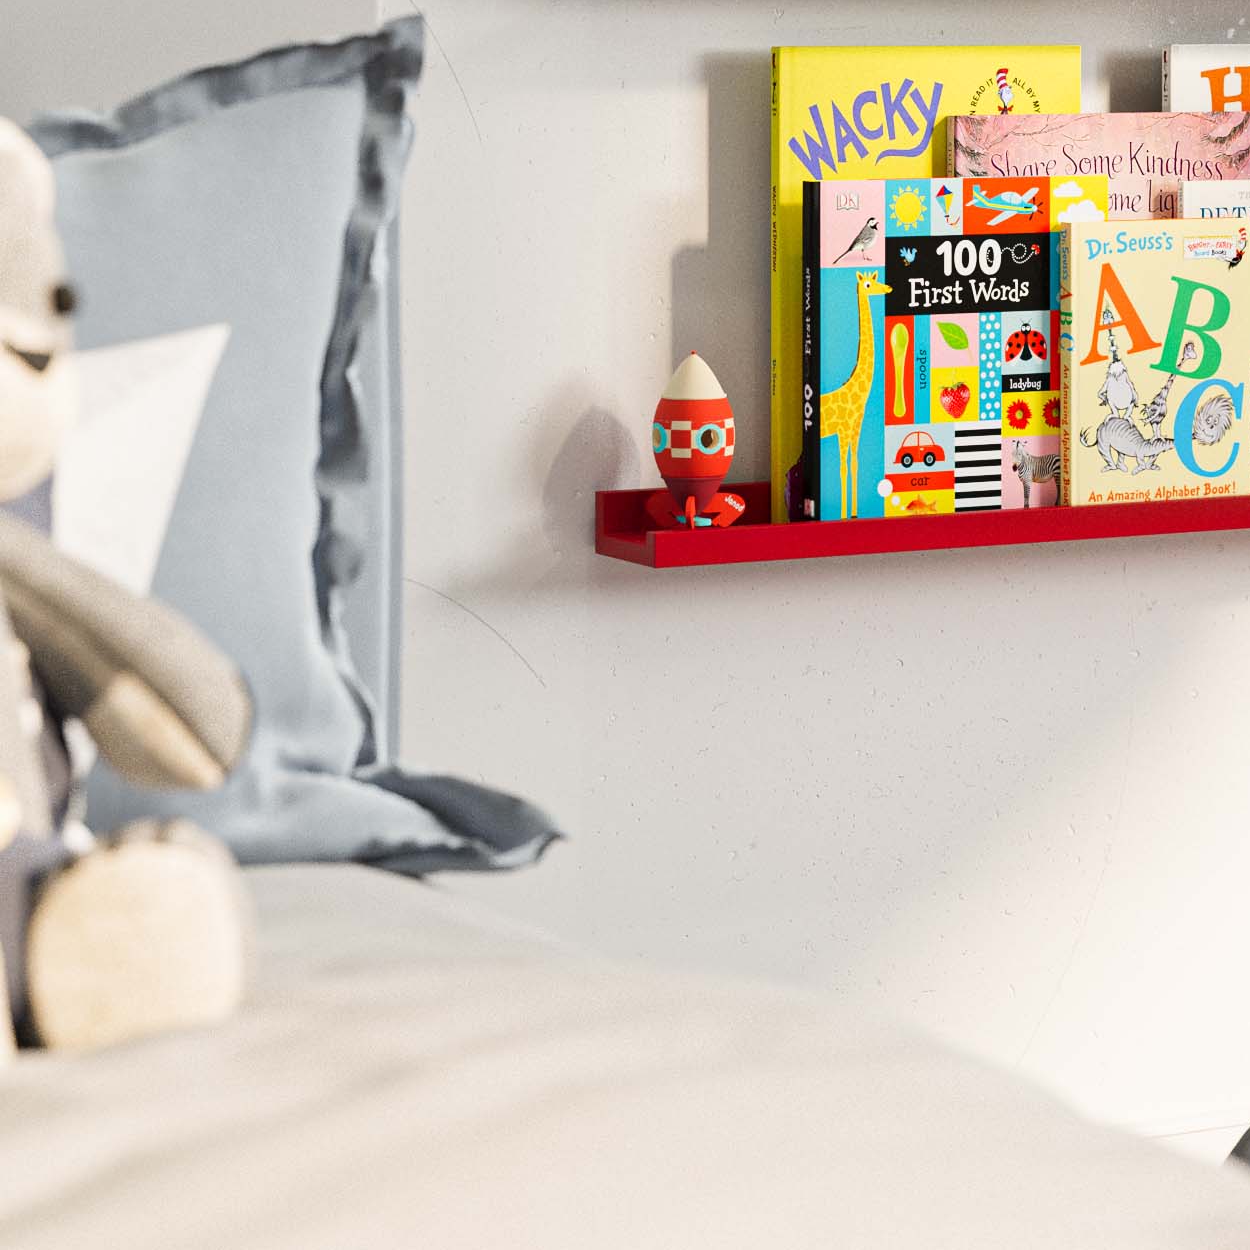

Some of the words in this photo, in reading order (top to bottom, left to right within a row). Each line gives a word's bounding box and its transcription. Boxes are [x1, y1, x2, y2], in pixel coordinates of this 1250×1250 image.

[971, 84, 986, 108] READ
[986, 78, 994, 87] IT
[1012, 77, 1026, 91] ALL
[1026, 87, 1037, 98] BY
[788, 78, 944, 180] WACKY
[990, 152, 1057, 177] Share
[1062, 144, 1123, 176] Some
[1128, 141, 1223, 181] Kindness
[838, 192, 859, 209] DK
[935, 238, 1001, 276] 100
[1086, 238, 1113, 260] Dr.
[1116, 231, 1174, 254] Seuss's
[908, 277, 962, 307] First
[968, 278, 1030, 303] Words
[919, 349, 928, 390] spoon
[1009, 378, 1042, 392] ladybug
[911, 476, 930, 488] car
[1088, 490, 1103, 503] An
[1107, 488, 1152, 503] Amazing
[1155, 485, 1201, 500] Alphabet
[1204, 480, 1237, 495] Book!
